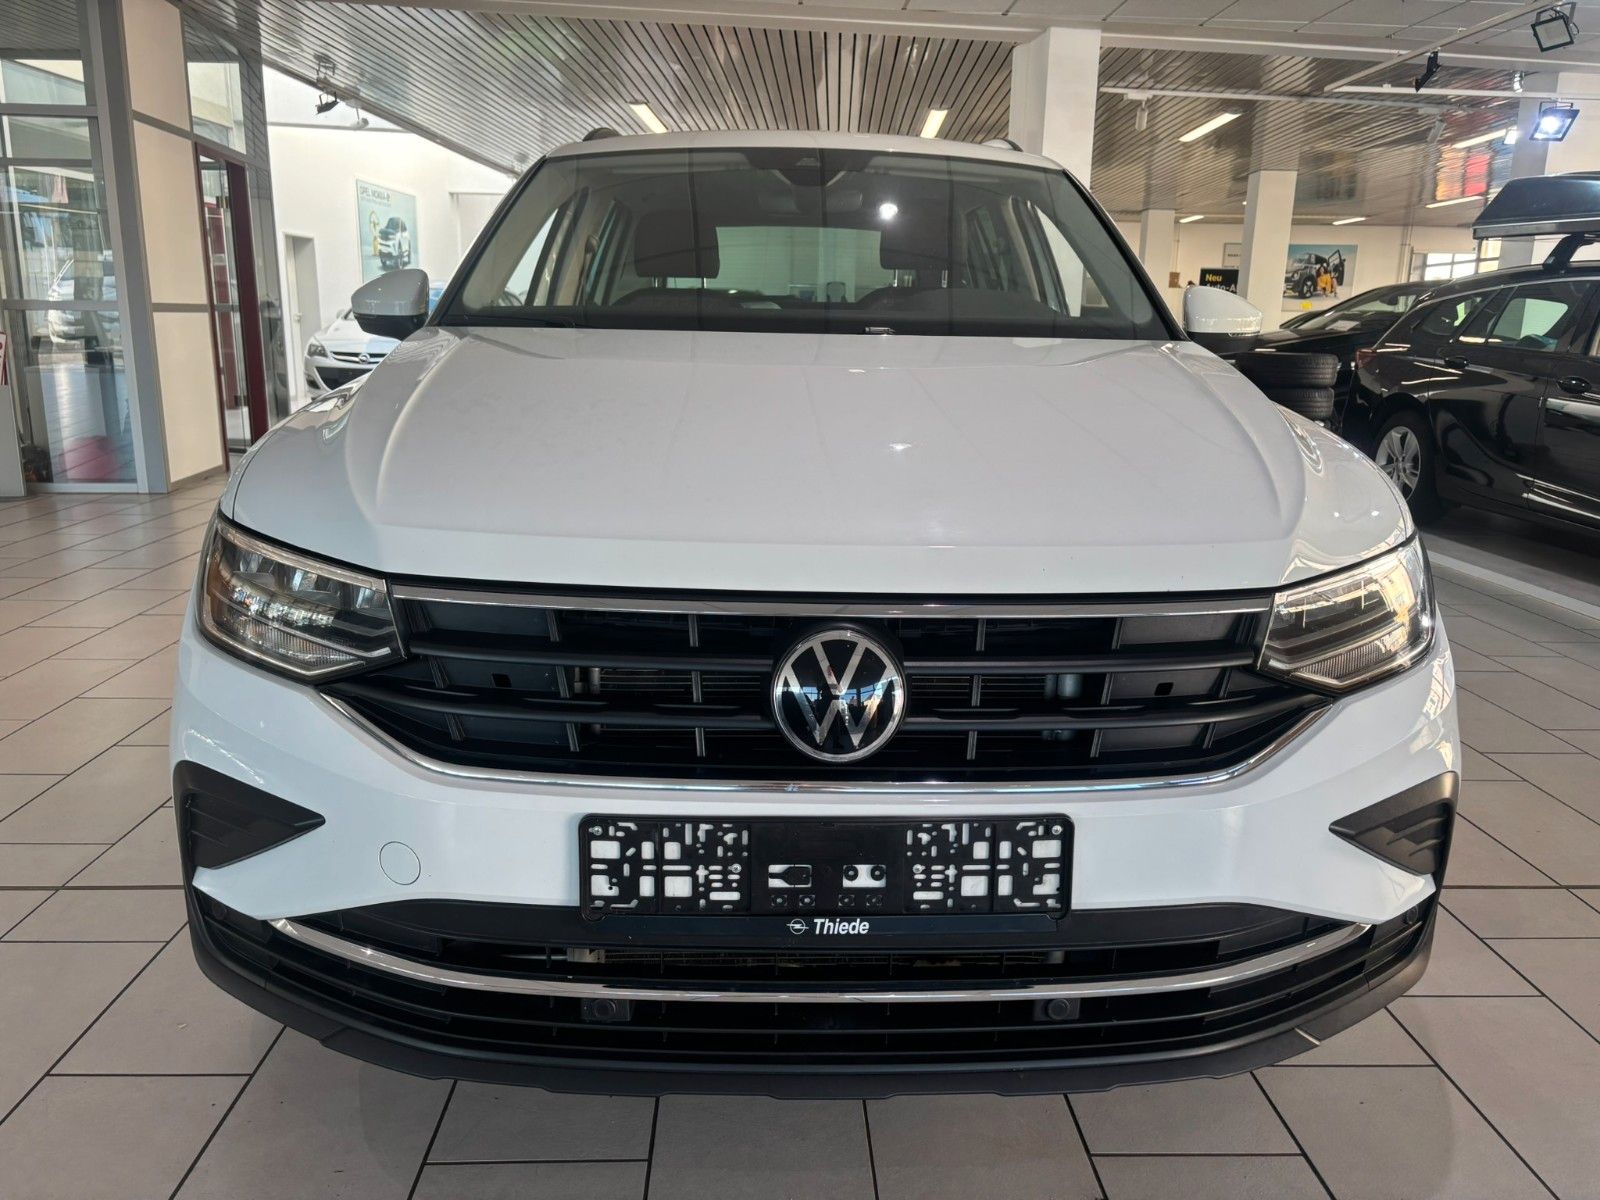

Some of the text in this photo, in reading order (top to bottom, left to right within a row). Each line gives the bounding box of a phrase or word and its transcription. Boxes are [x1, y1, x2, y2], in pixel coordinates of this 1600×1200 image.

[1205, 273, 1222, 282] Neu
[775, 631, 902, 757] VW
[813, 918, 870, 935] Thiede
